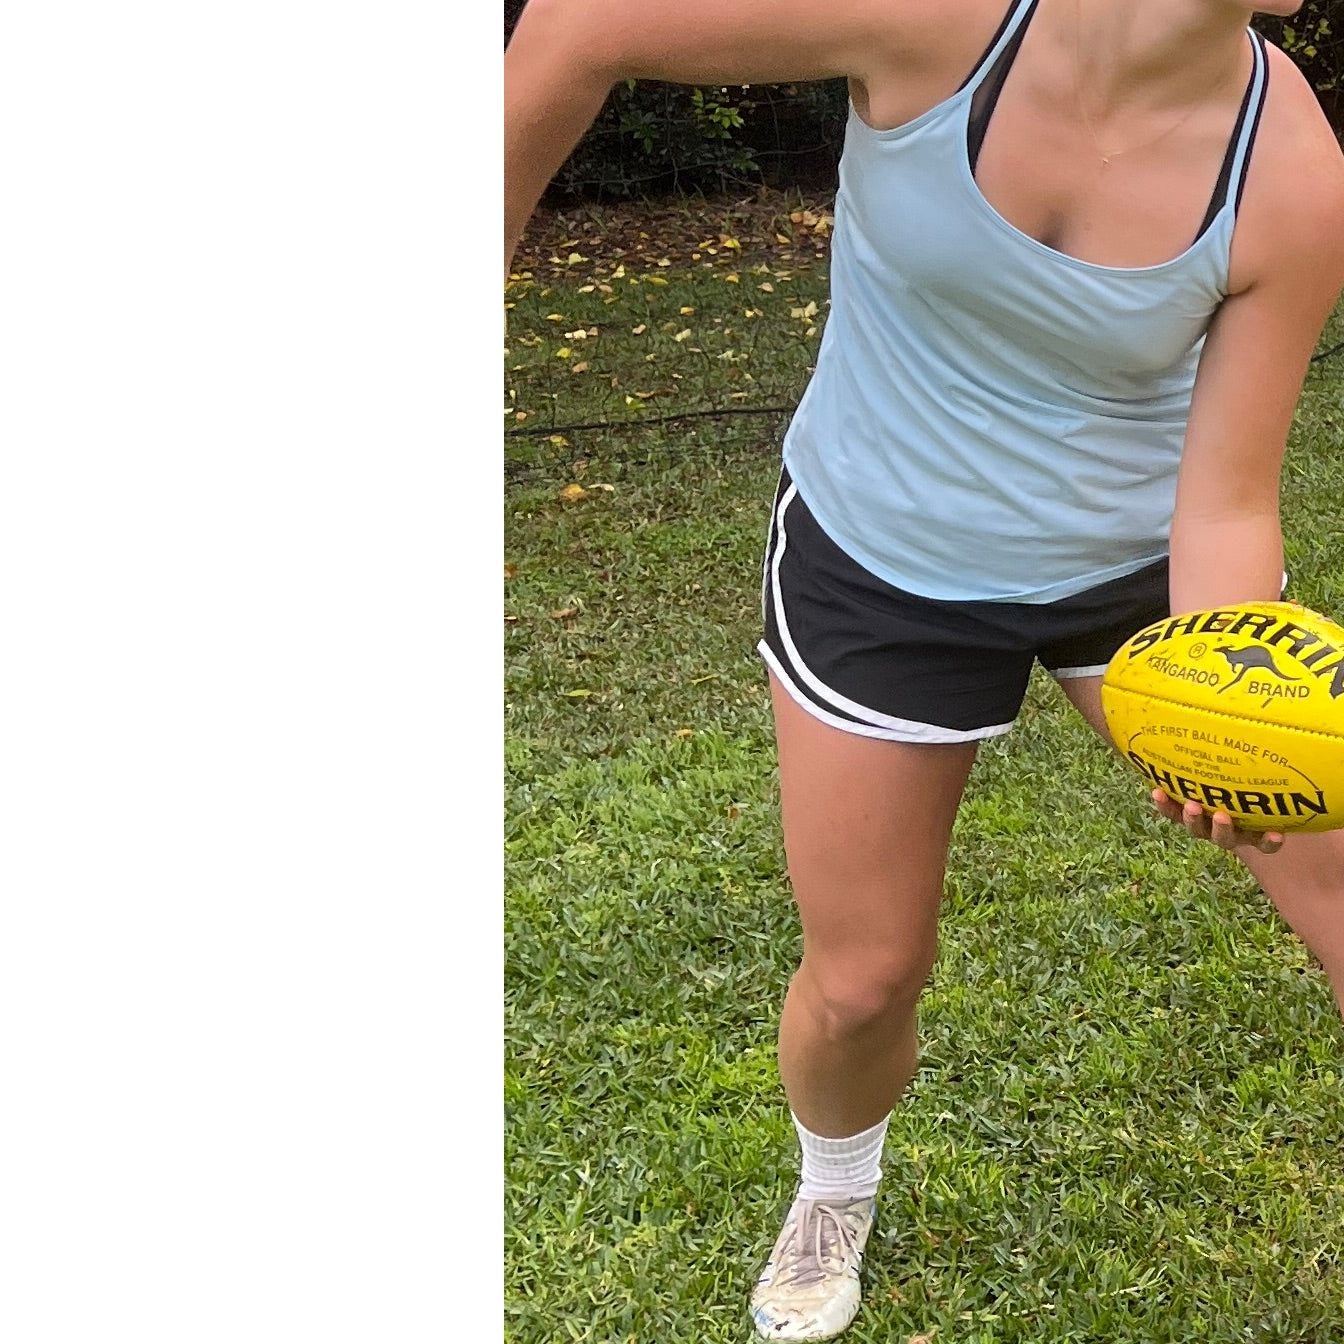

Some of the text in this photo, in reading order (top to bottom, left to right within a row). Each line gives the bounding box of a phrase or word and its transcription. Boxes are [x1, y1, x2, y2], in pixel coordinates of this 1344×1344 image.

[1146, 655, 1311, 699] KANGAROO BRAND
[1141, 725, 1289, 767] THE FIRST BALL MADE FOR
[1216, 754, 1241, 766] BALL
[1194, 768, 1244, 784] FOOTBALL
[1248, 777, 1289, 786] LEAGUE
